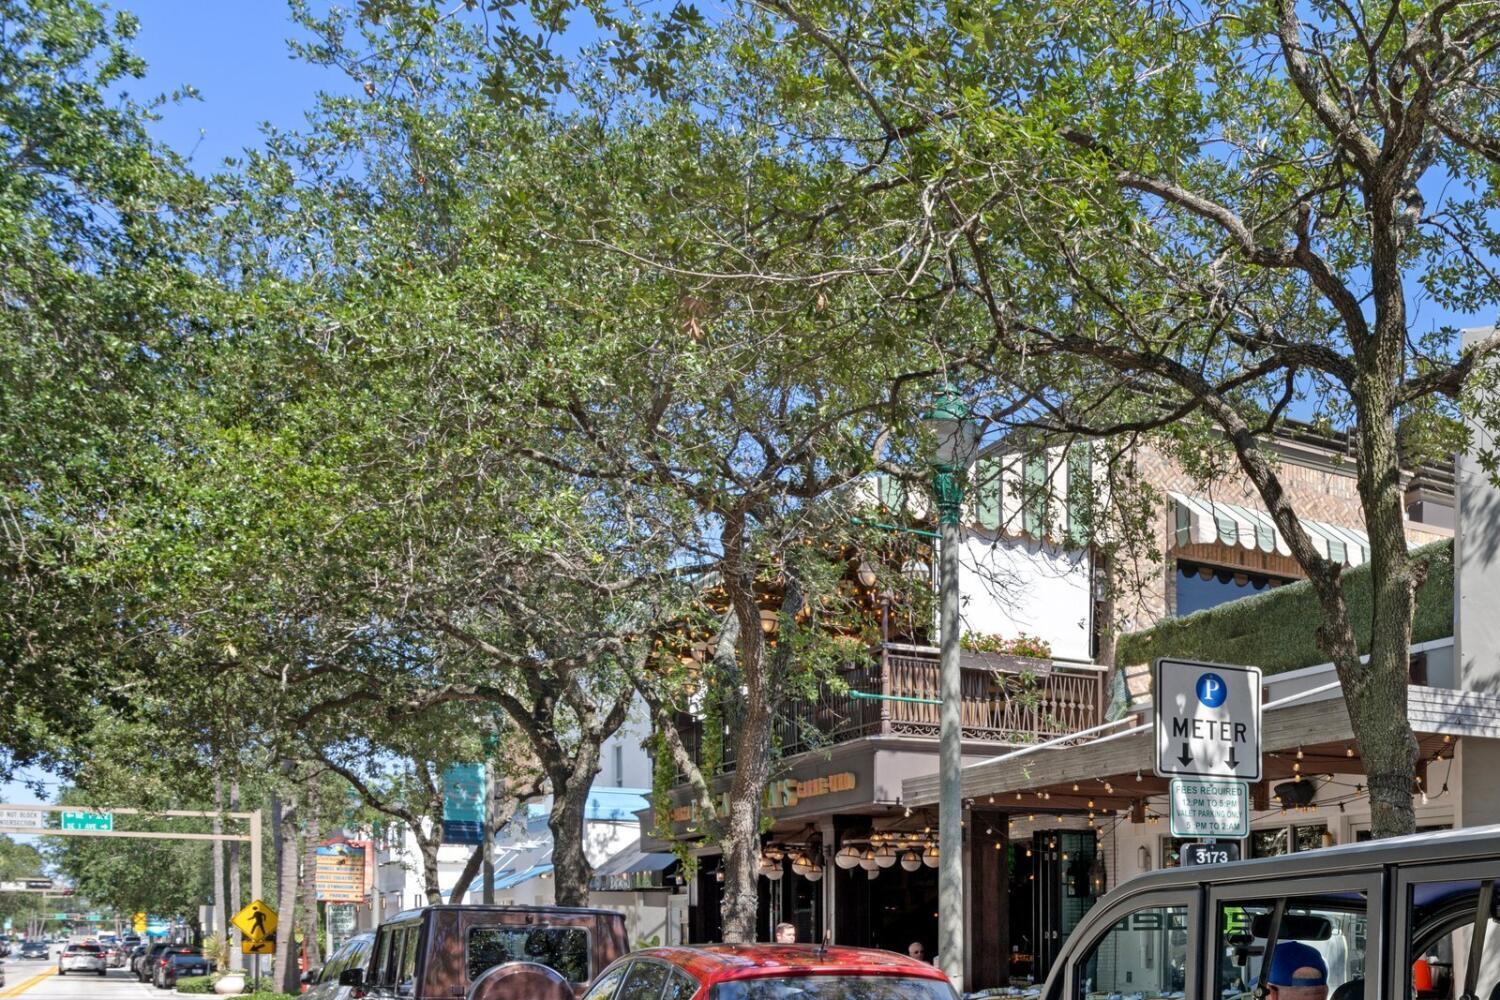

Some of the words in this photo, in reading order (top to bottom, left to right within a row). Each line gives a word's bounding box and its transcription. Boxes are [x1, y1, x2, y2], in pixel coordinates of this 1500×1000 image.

[1204, 678, 1219, 700] P
[1173, 716, 1247, 743] METER
[1176, 785, 1198, 795] FEES
[1200, 786, 1243, 797] REQUIRED
[1207, 799, 1218, 807] TO
[1198, 810, 1226, 818] PARKING
[1226, 811, 1243, 819] ONLY
[1209, 822, 1220, 831] TO
[1196, 851, 1229, 864] 3173
